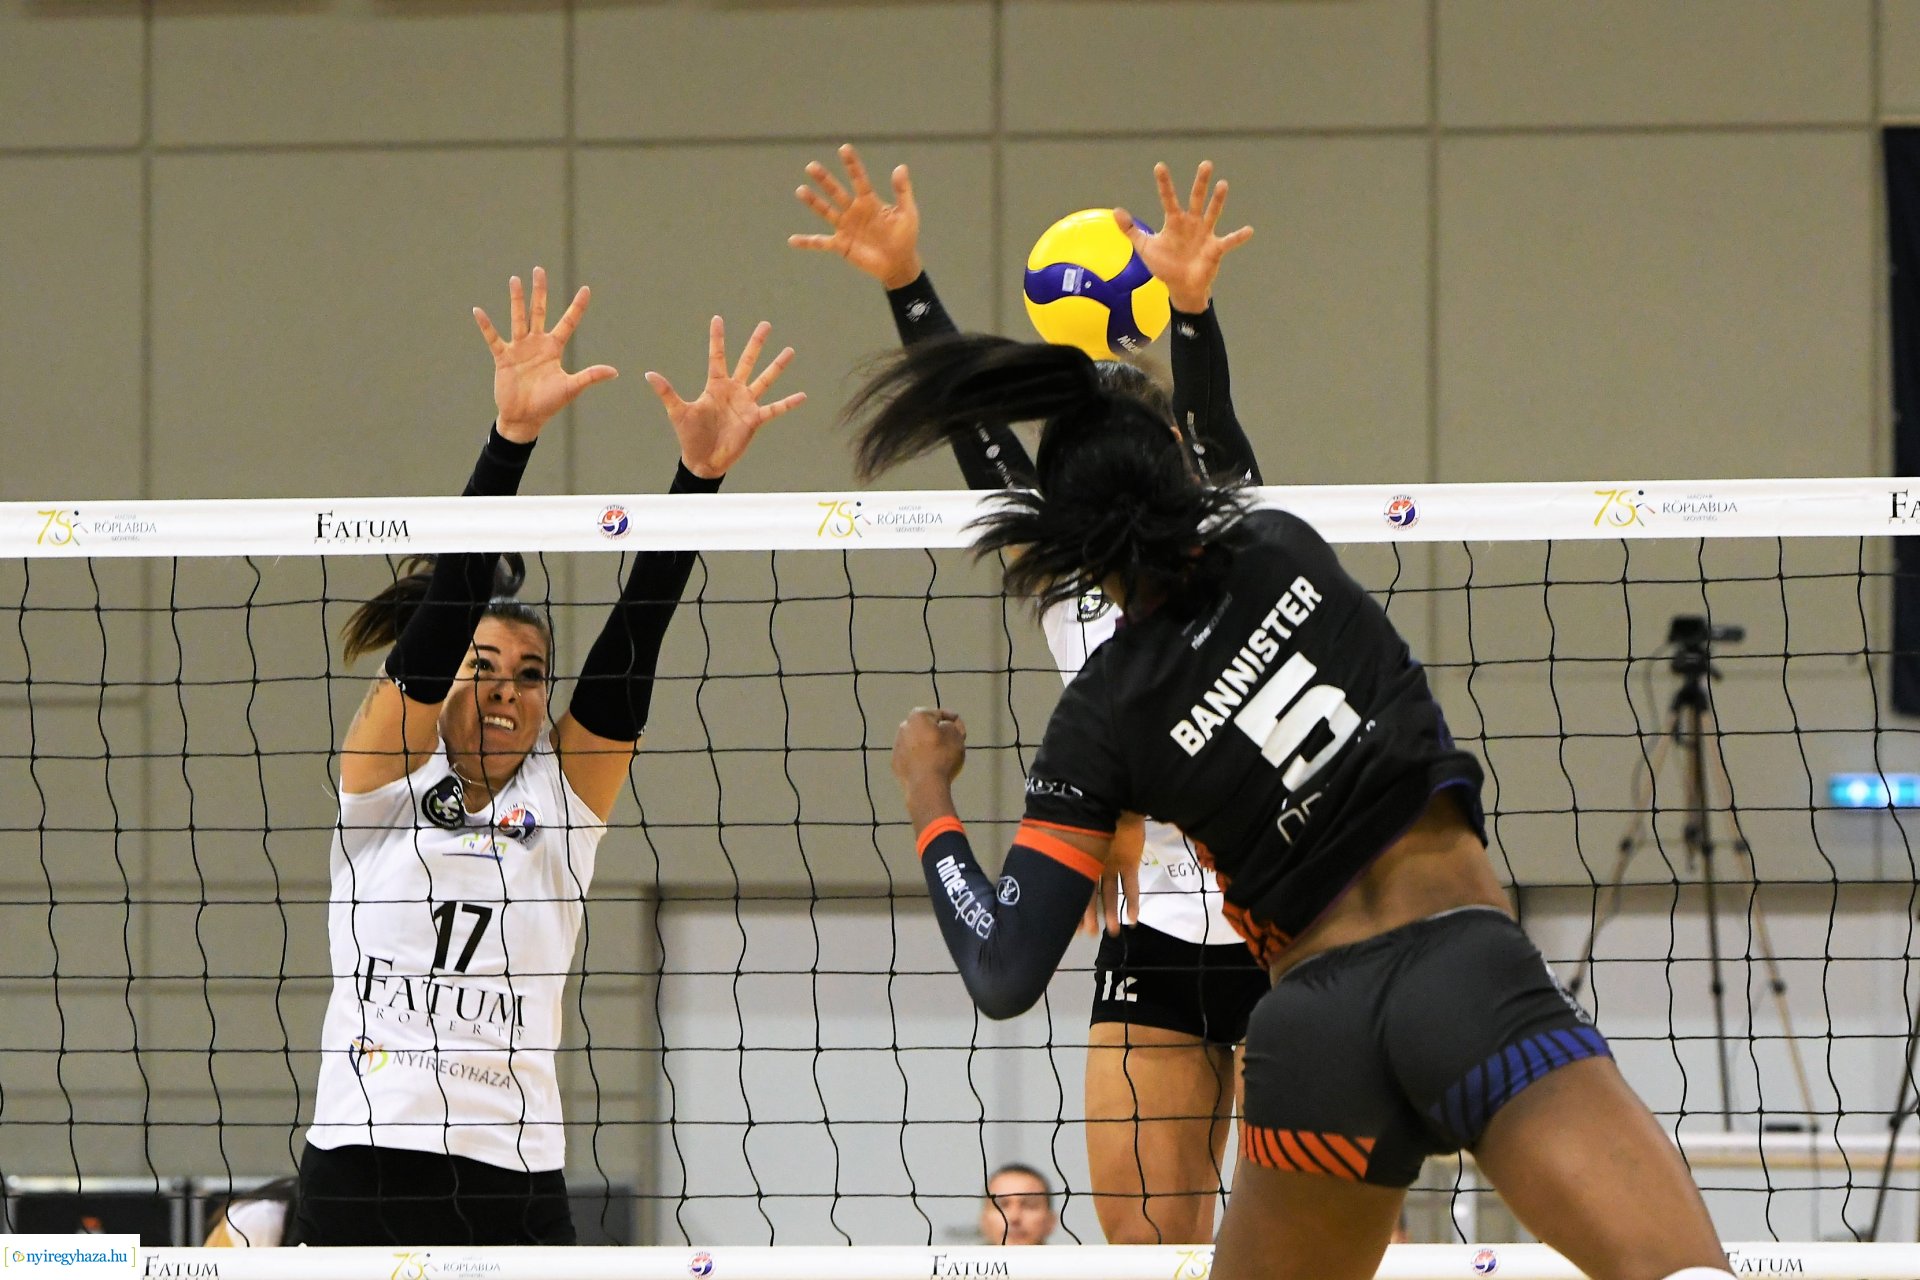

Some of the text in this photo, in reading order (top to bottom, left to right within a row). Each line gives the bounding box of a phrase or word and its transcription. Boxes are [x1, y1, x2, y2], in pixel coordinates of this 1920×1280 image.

[877, 512, 943, 525] RÖPLABDA
[1662, 500, 1738, 514] RÖPLABDA
[94, 520, 158, 533] RÖPLABDA
[315, 510, 412, 539] FATUM
[1170, 575, 1324, 758] BANNISTER
[1233, 651, 1362, 793] 5
[935, 854, 995, 940] ninesquare
[432, 900, 494, 974] 17
[361, 954, 527, 1027] FATUM
[144, 1254, 219, 1276] FATUM
[932, 1253, 1009, 1276] FATUM
